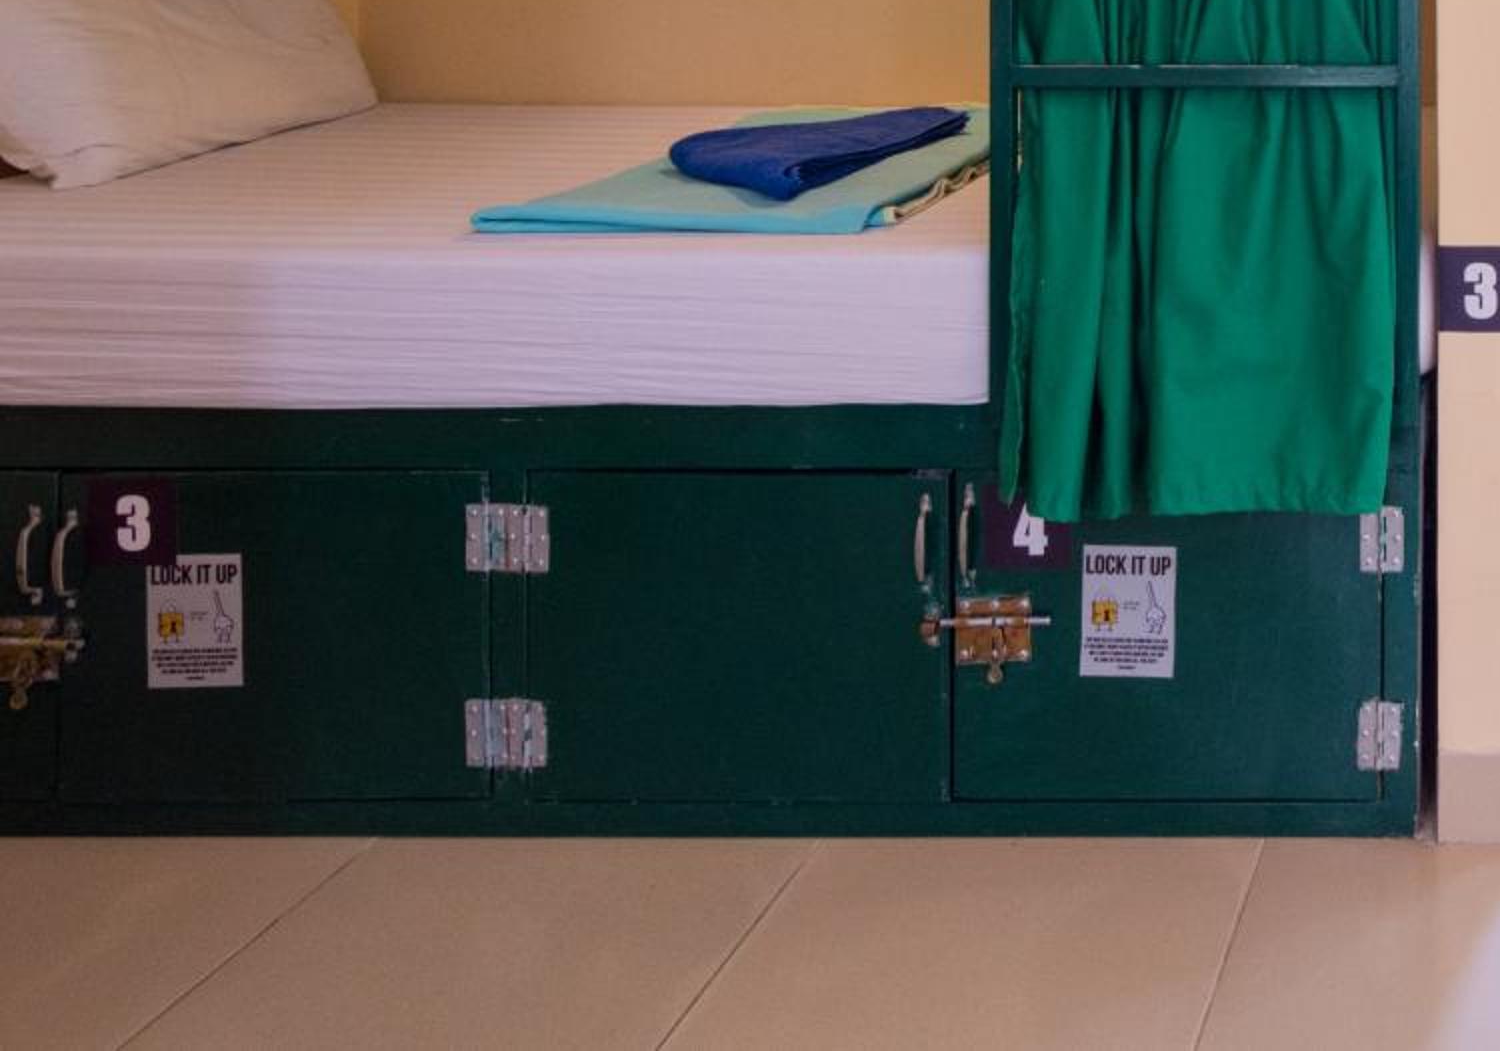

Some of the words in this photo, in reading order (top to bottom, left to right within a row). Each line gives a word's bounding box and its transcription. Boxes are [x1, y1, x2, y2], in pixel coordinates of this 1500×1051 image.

[1463, 262, 1499, 320] 3
[115, 493, 152, 552] 3
[1013, 501, 1049, 556] 4
[150, 564, 193, 585] LOCK
[197, 564, 212, 585] IT
[216, 564, 238, 584] UP
[1085, 554, 1127, 575] LOCK
[1131, 555, 1146, 575] IT
[1150, 555, 1172, 576] UP
